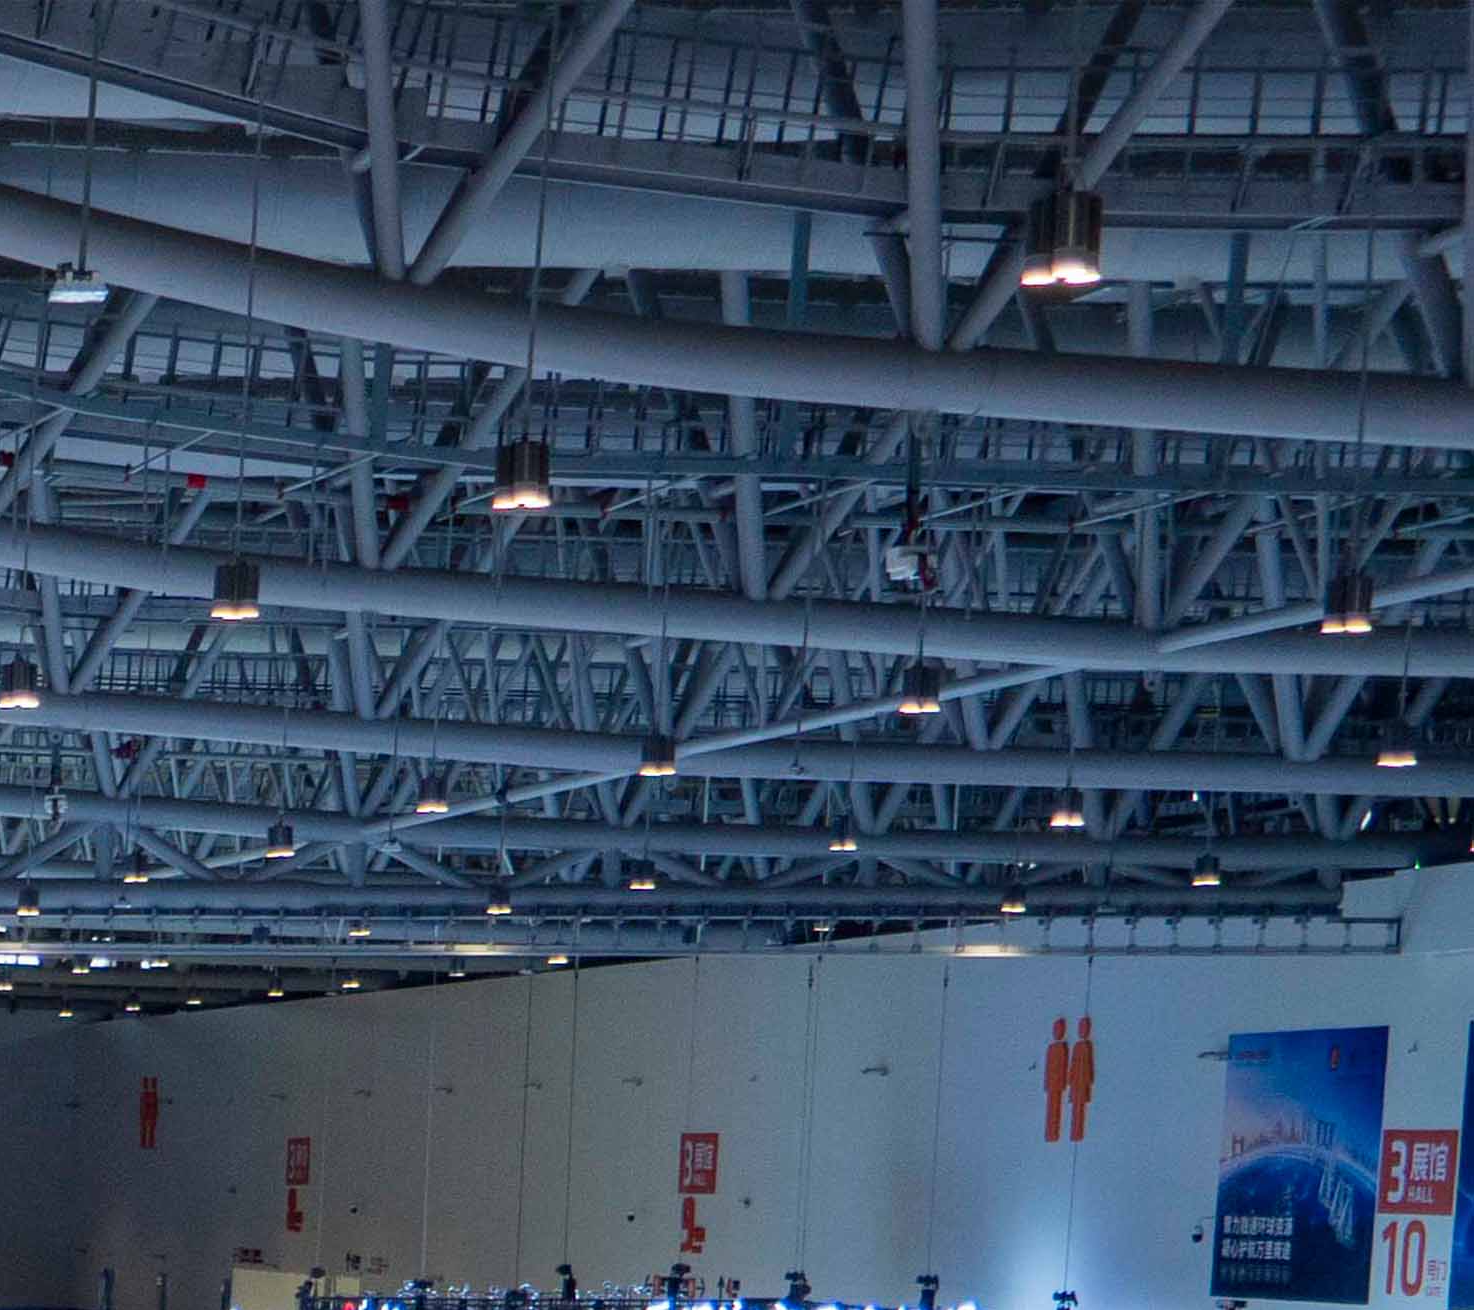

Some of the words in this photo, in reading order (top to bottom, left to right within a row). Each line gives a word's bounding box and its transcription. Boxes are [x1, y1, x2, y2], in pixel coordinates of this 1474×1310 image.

[1386, 1141, 1407, 1204] 3
[1410, 1143, 1448, 1181] 展馆
[1381, 1220, 1426, 1297] 10
